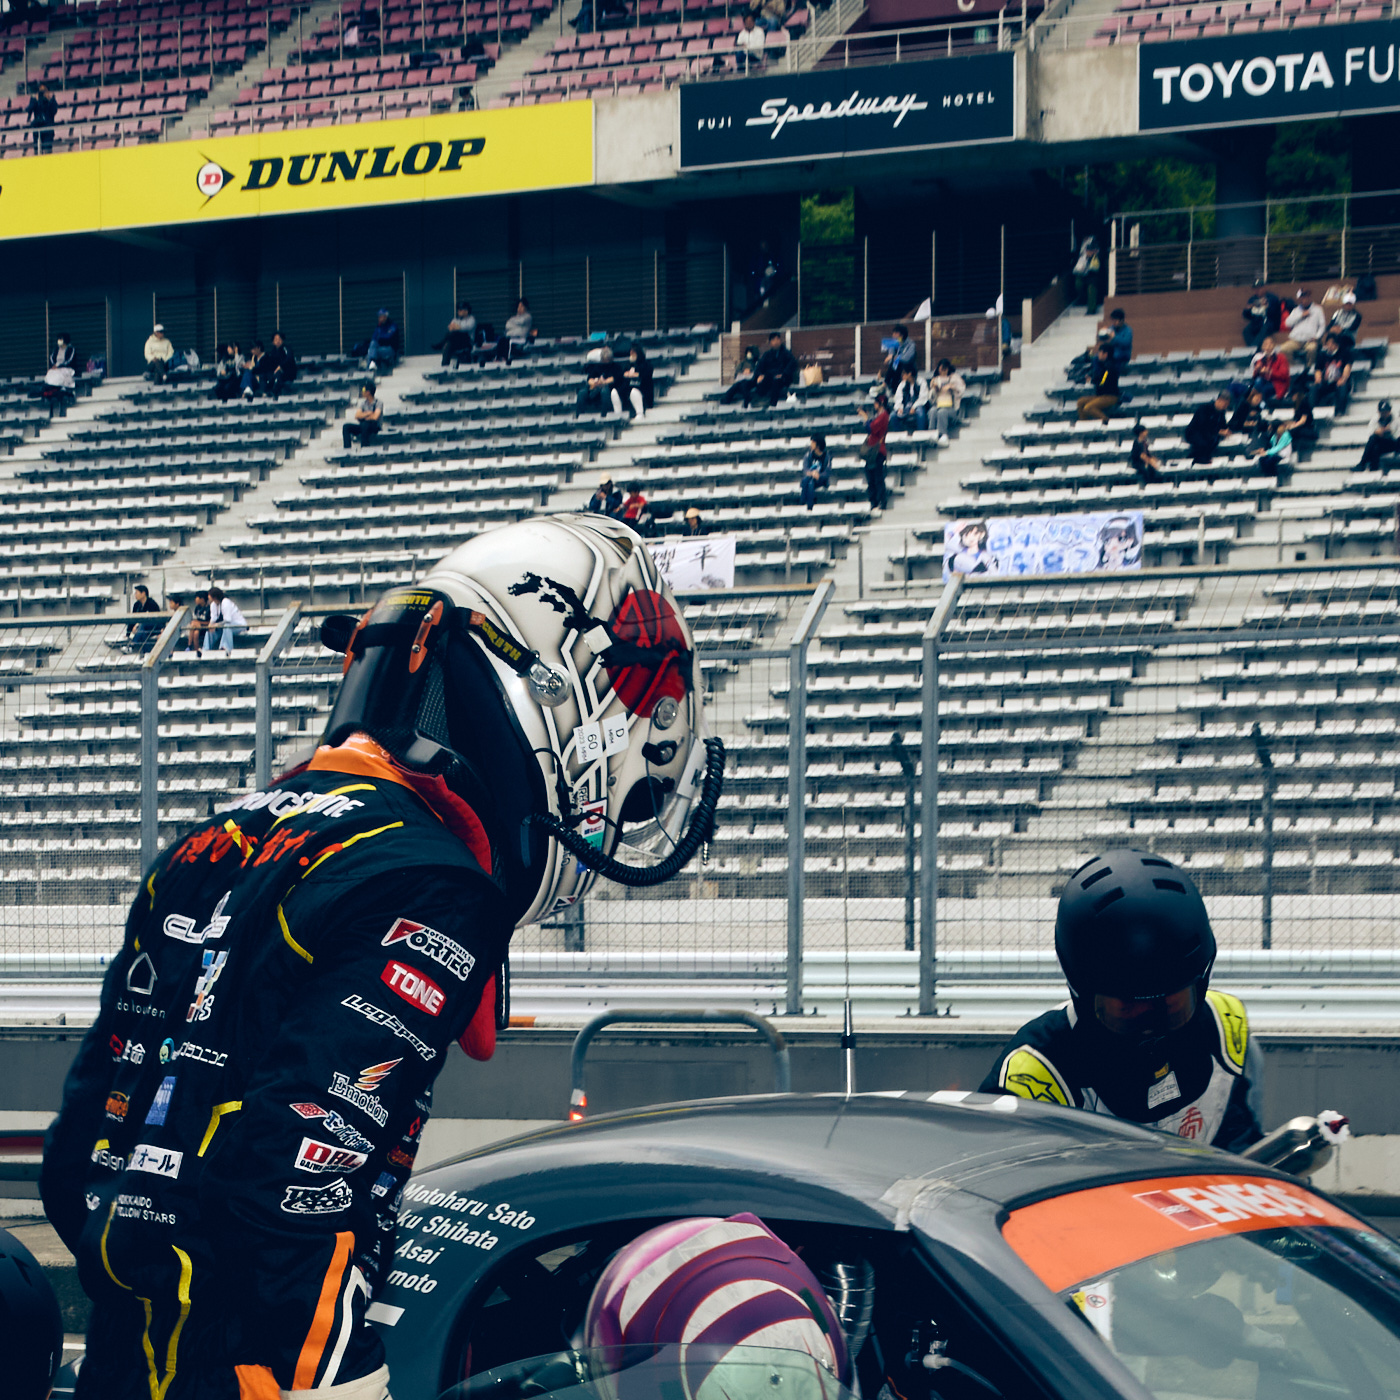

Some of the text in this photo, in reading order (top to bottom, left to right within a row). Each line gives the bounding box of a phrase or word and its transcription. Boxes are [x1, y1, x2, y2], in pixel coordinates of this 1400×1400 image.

[1153, 53, 1334, 104] TOYOTA
[698, 90, 995, 139] FUJI Speedway HOTEL
[241, 137, 486, 192] DUNLOP
[587, 733, 599, 750] 60
[390, 963, 444, 1015] TONE
[328, 1071, 390, 1128] Emotion
[303, 1142, 363, 1169] DRL
[143, 1210, 177, 1225] STARS
[403, 1183, 488, 1217] Motoharu
[487, 1203, 536, 1231] Sato
[1167, 1184, 1325, 1223] ENEOS
[396, 1237, 446, 1265] Asai
[422, 1215, 499, 1251] Shibata
